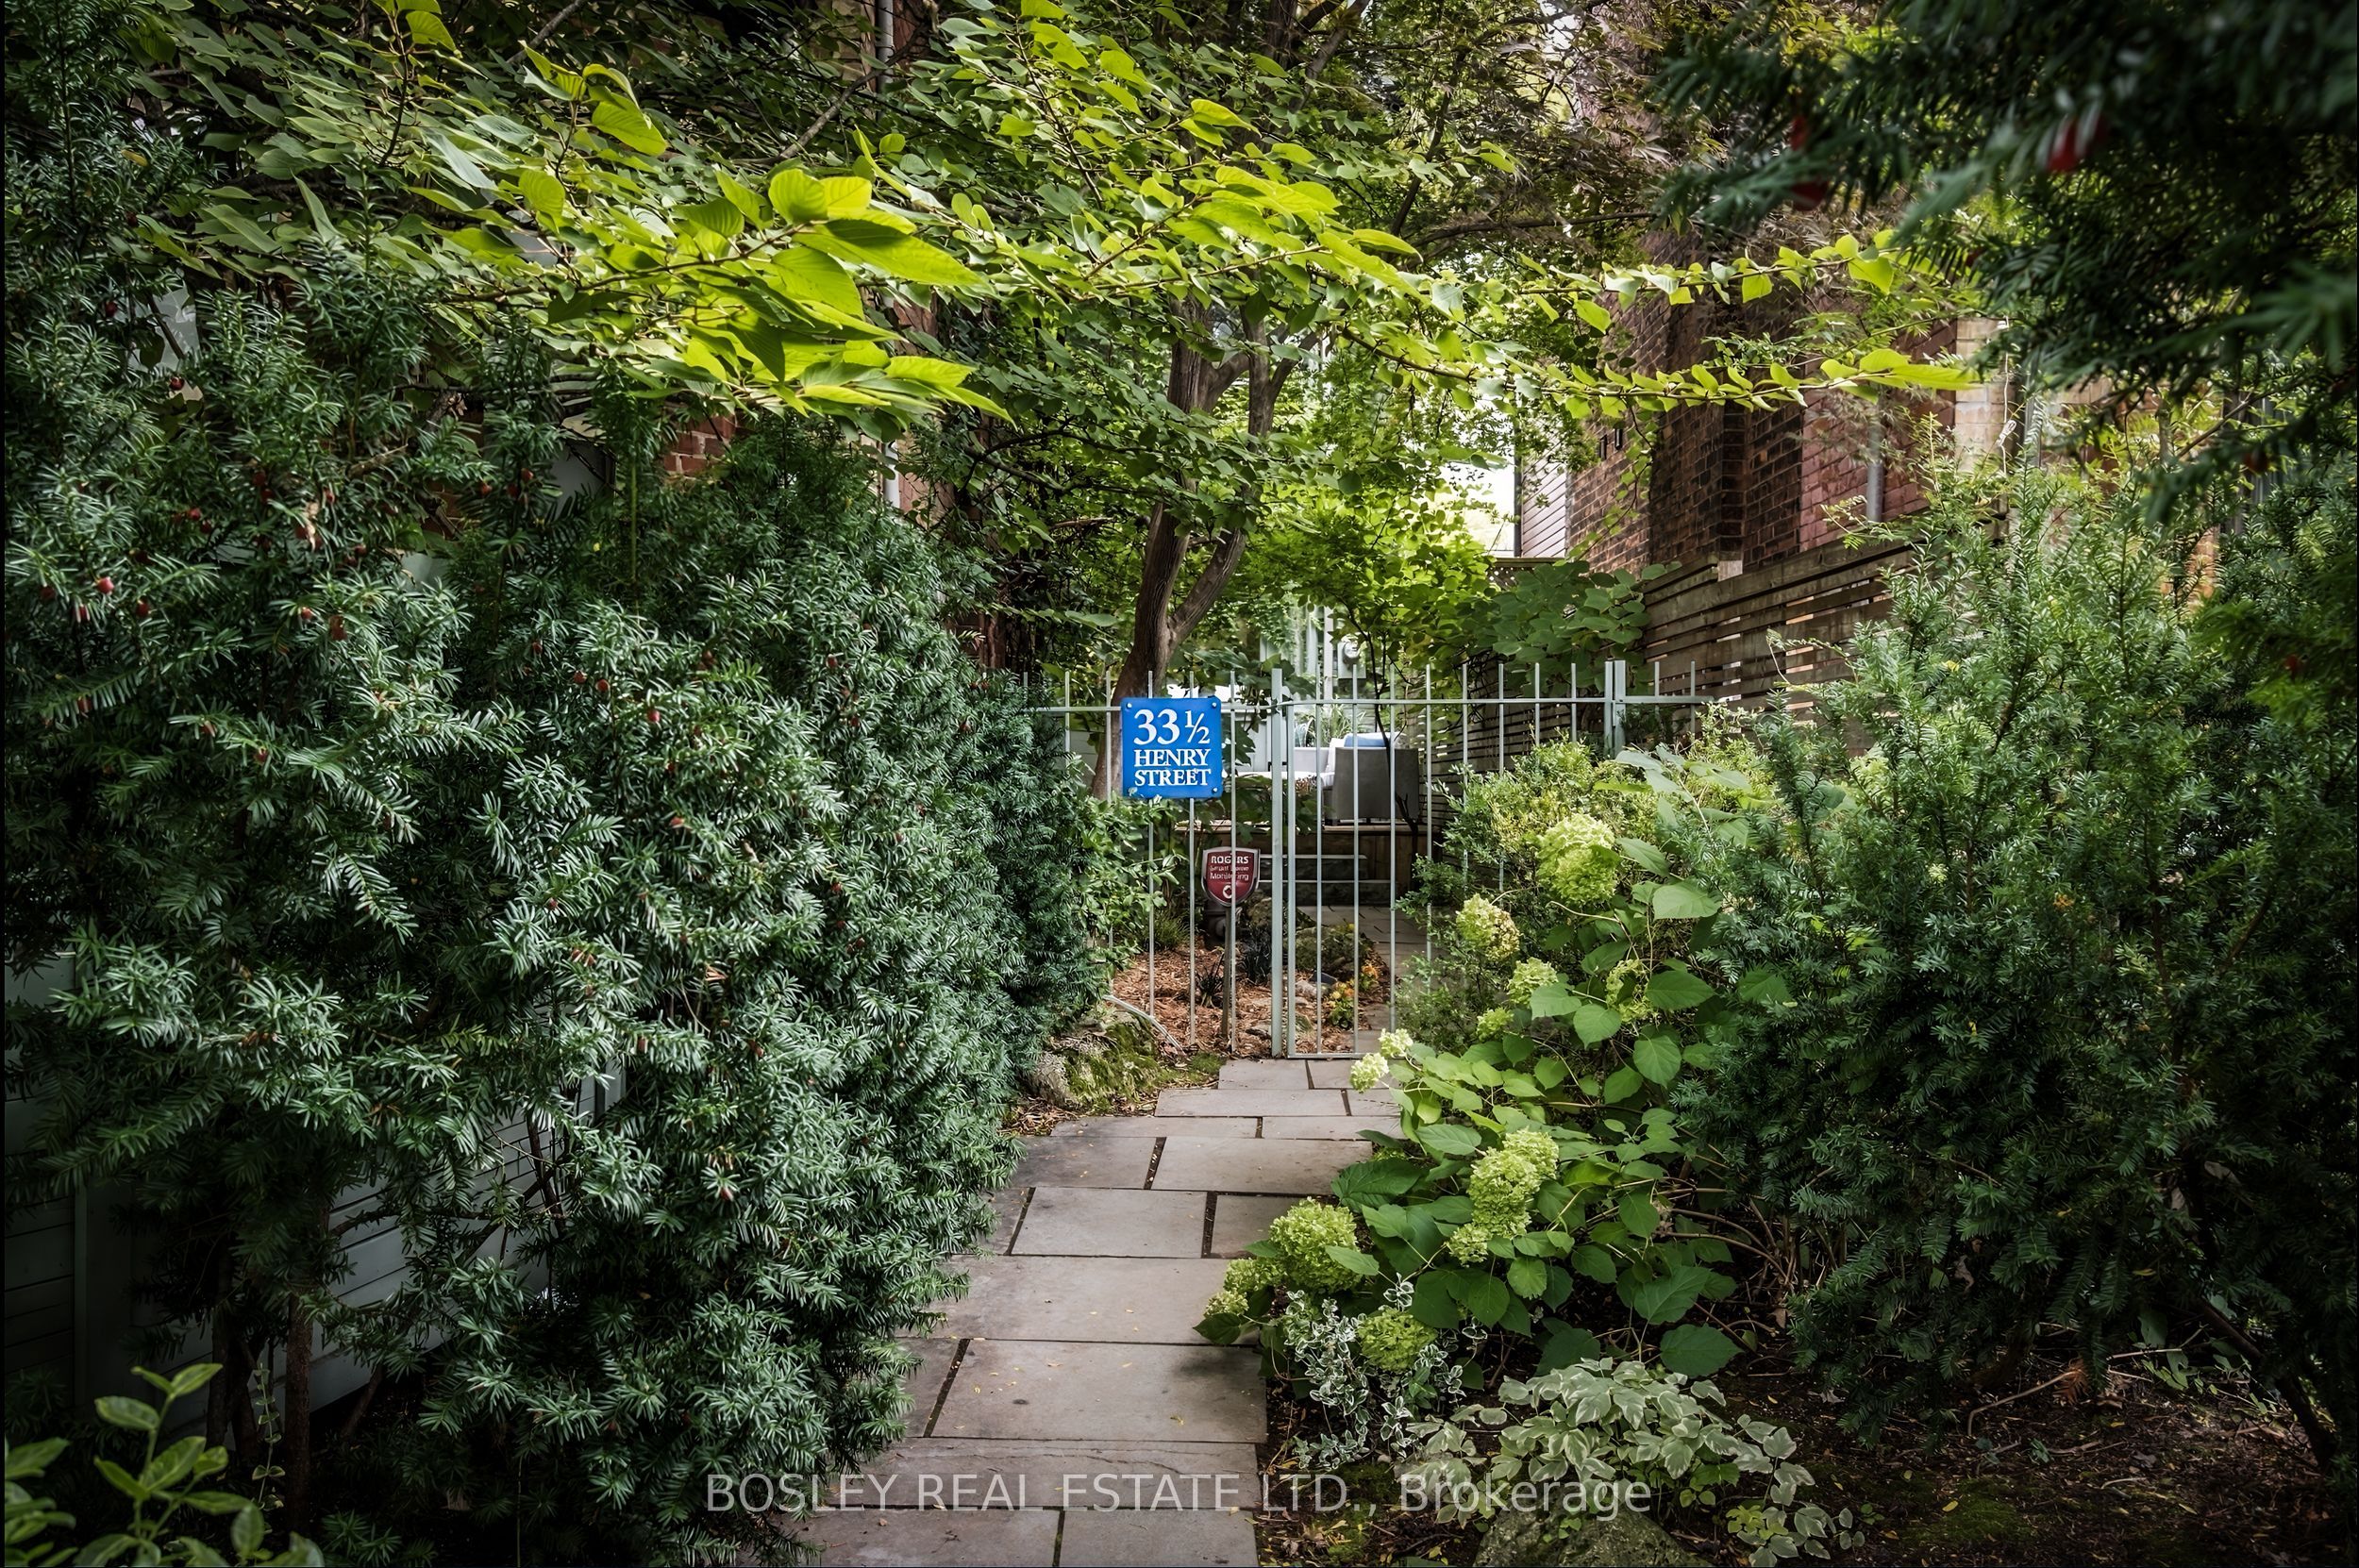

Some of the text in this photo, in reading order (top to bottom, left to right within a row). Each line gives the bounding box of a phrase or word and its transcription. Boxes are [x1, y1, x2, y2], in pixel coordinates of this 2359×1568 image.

[1133, 748, 1211, 767] HENRY
[1134, 769, 1212, 787] STREET
[1211, 856, 1249, 864] ROGRS
[1210, 873, 1249, 881] Moniting
